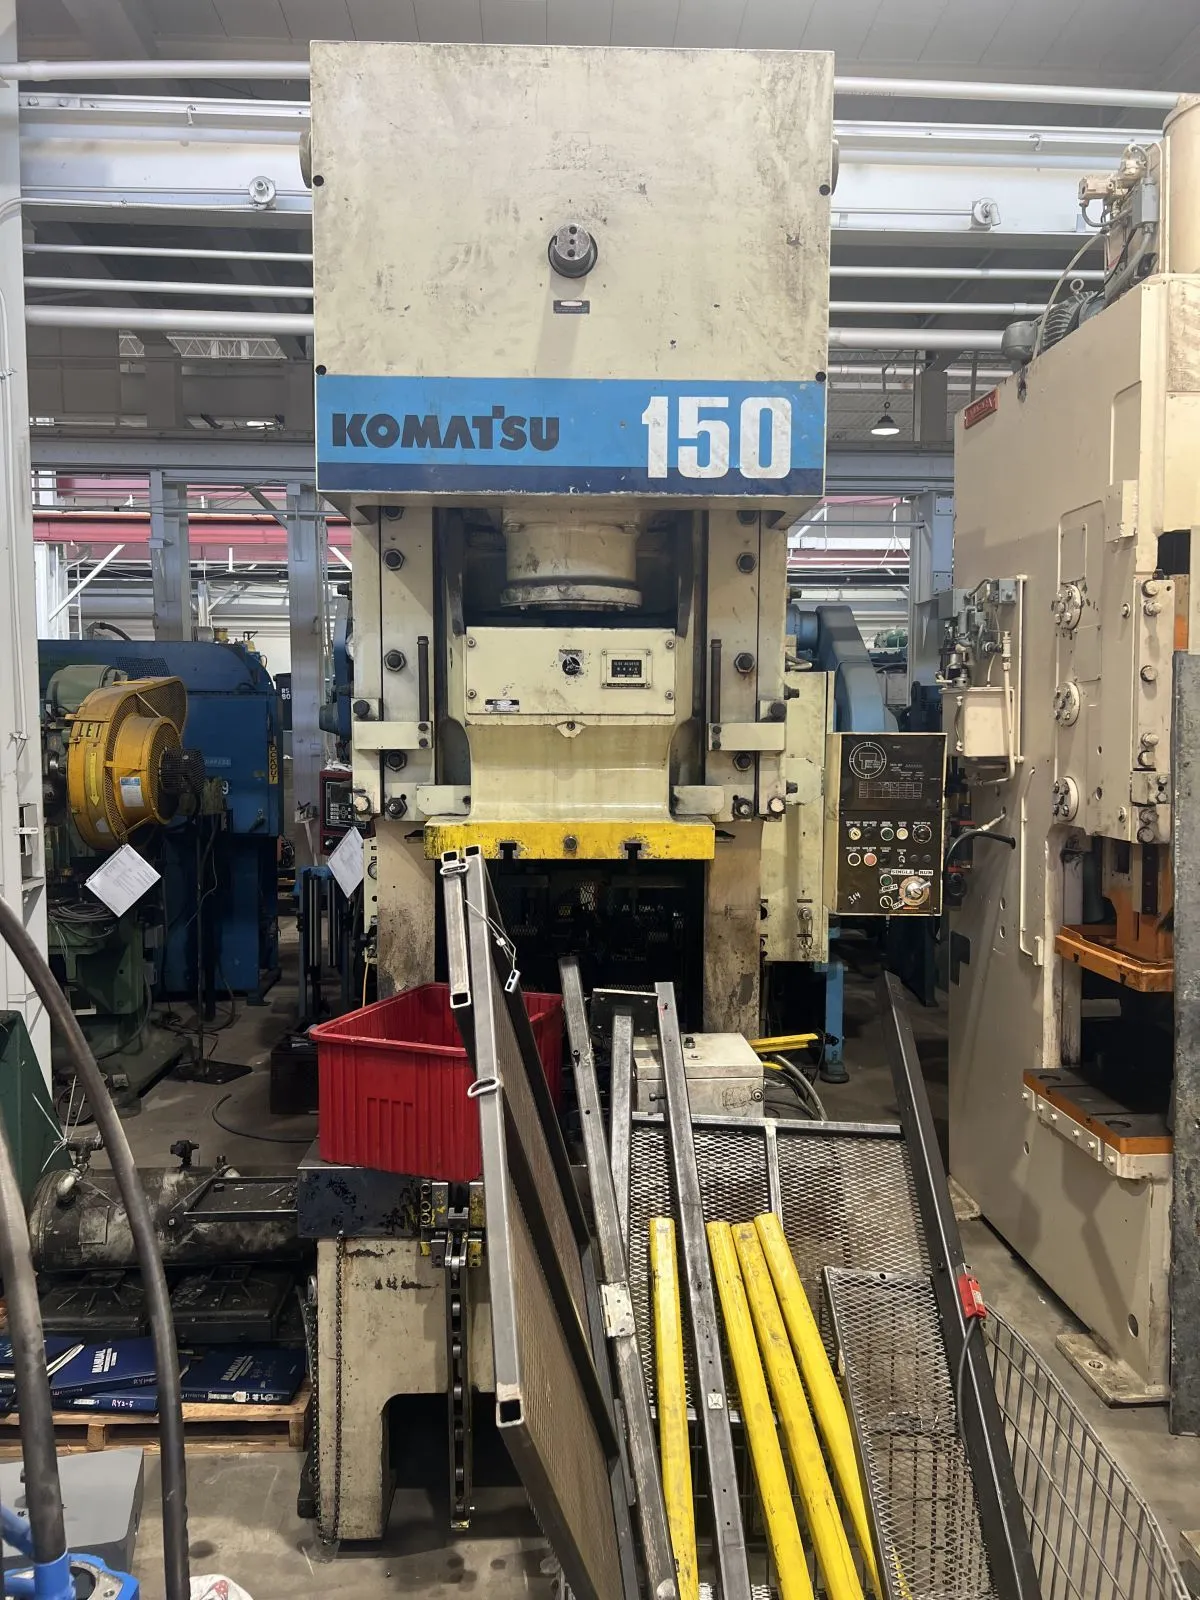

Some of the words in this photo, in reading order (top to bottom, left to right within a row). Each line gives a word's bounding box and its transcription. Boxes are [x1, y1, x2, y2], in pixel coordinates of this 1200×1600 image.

[332, 405, 560, 451] KOMATSU
[641, 396, 792, 479] 150
[270, 743, 278, 783] OCKOUT
